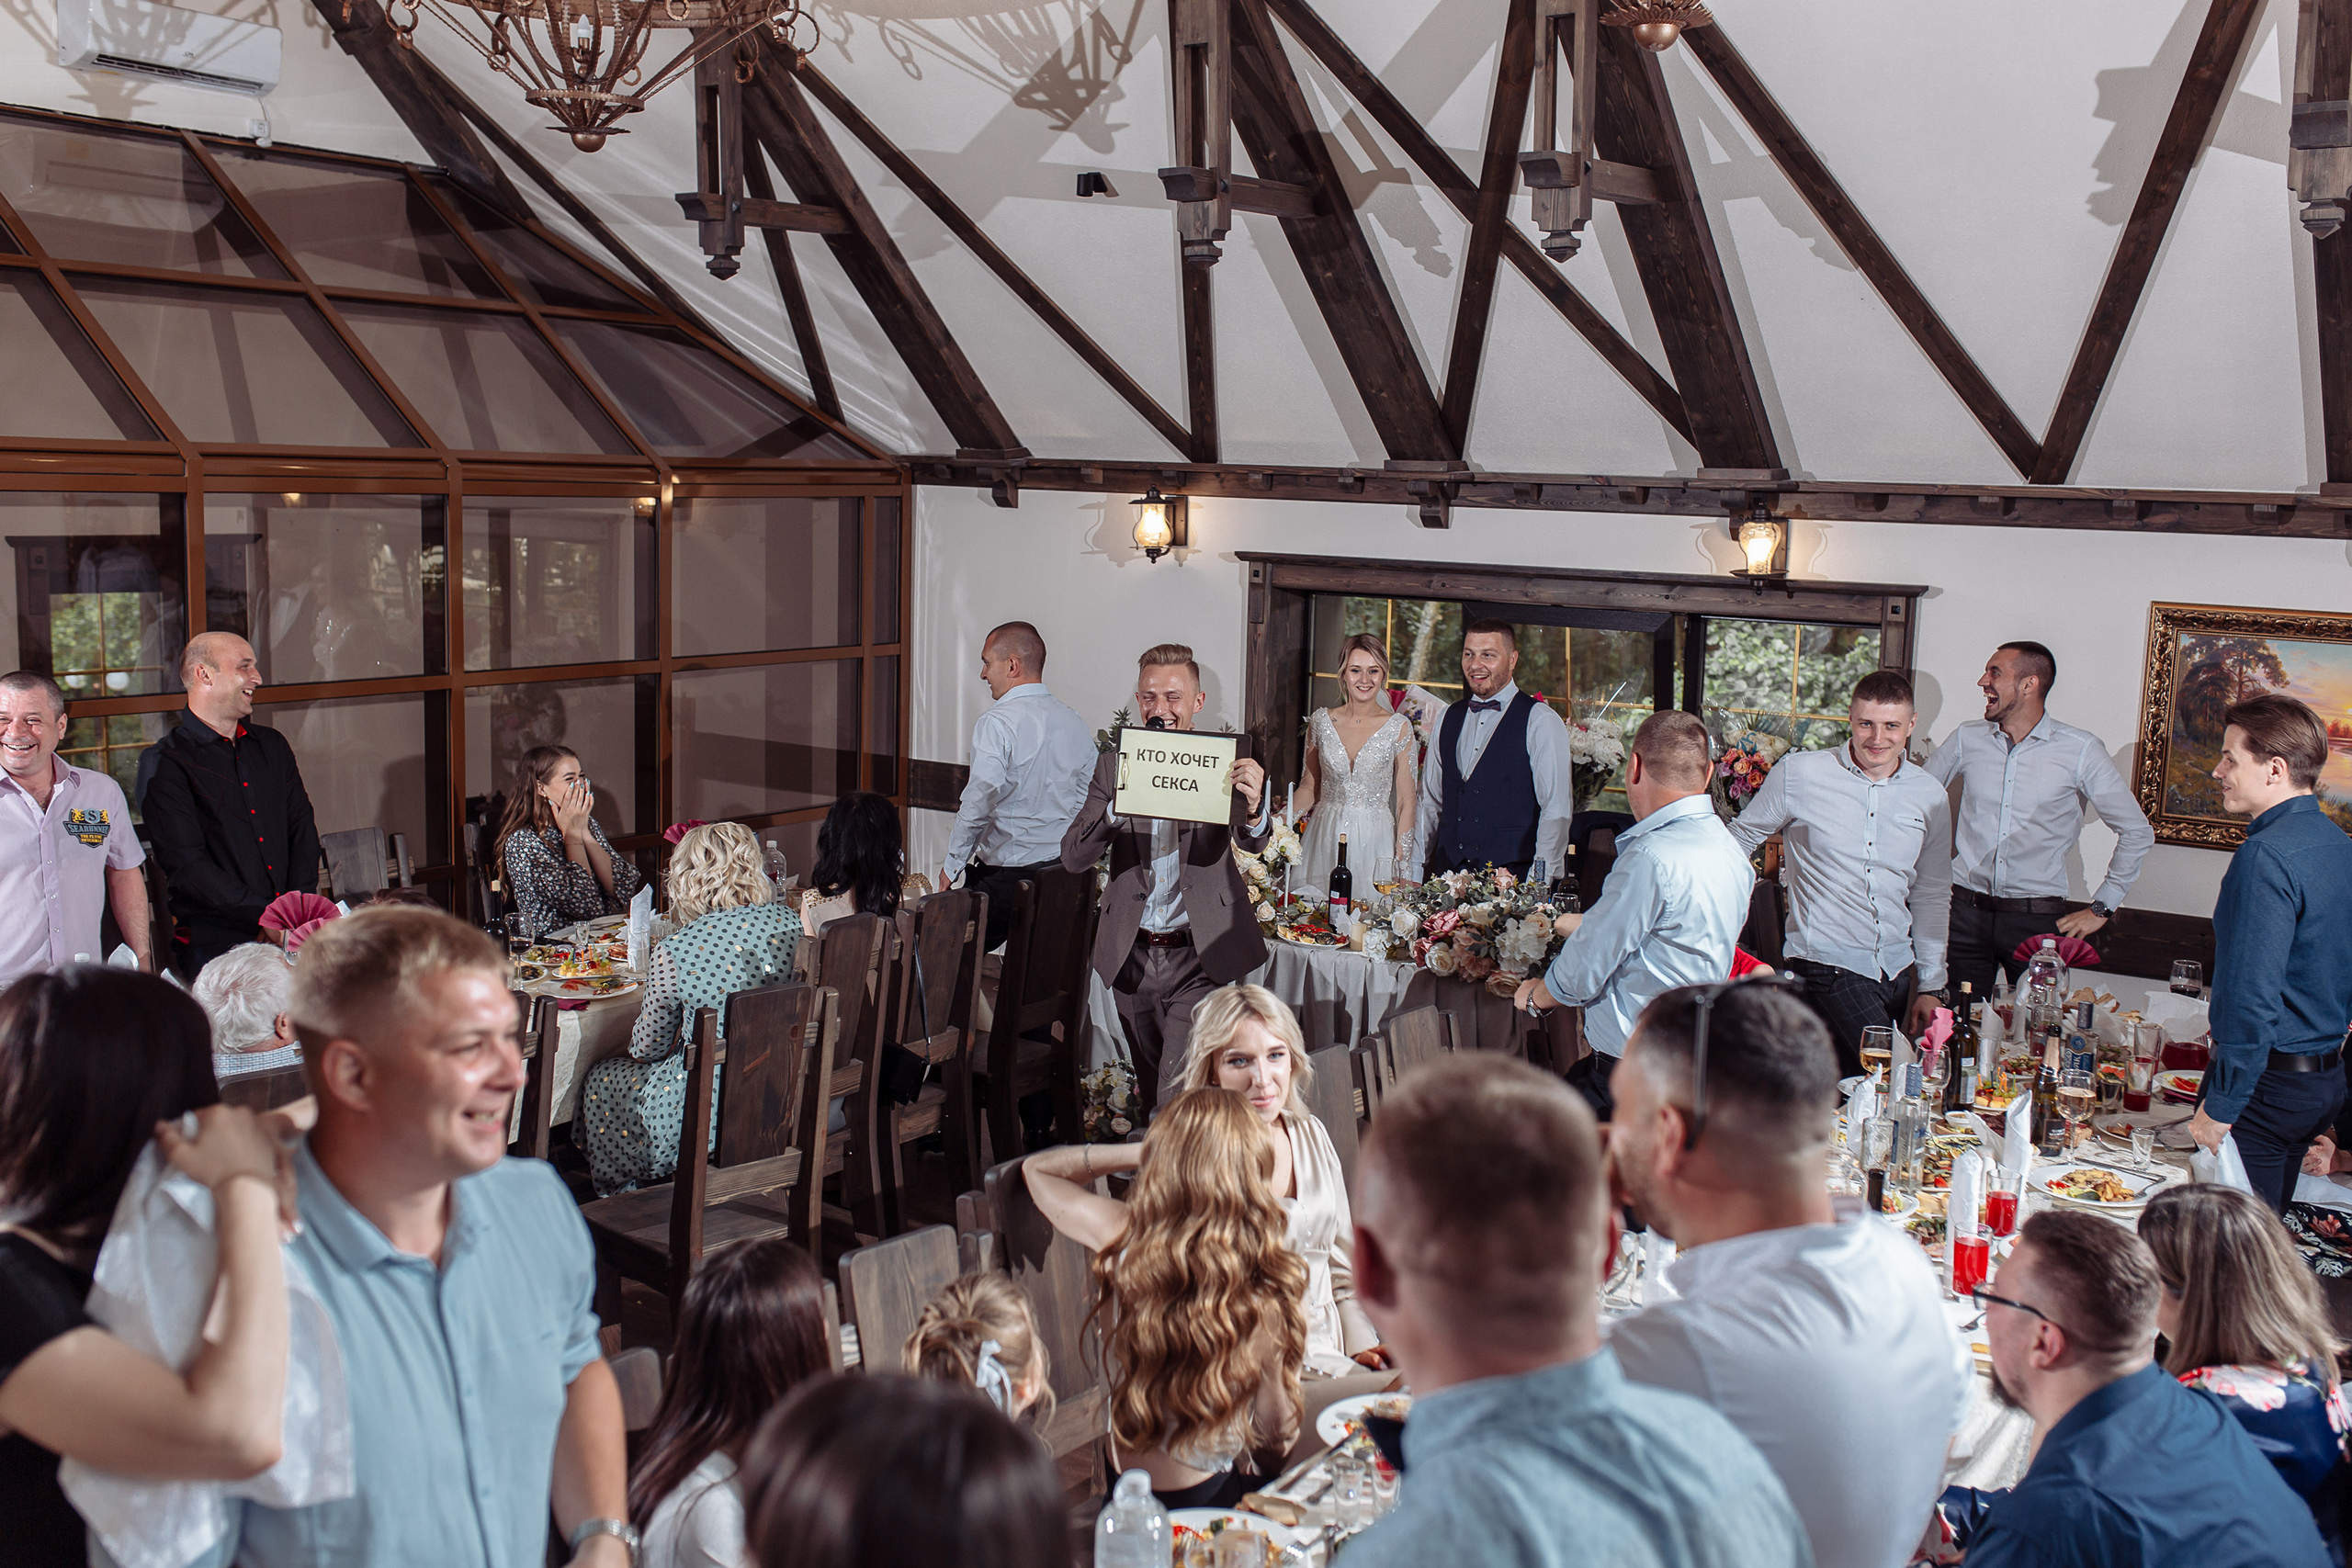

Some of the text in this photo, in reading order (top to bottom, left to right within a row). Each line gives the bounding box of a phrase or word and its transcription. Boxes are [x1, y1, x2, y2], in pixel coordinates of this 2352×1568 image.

[1137, 749, 1219, 768] КТО ХОЧЕТ
[1152, 775, 1198, 792] СЕКСА
[88, 810, 96, 821] S
